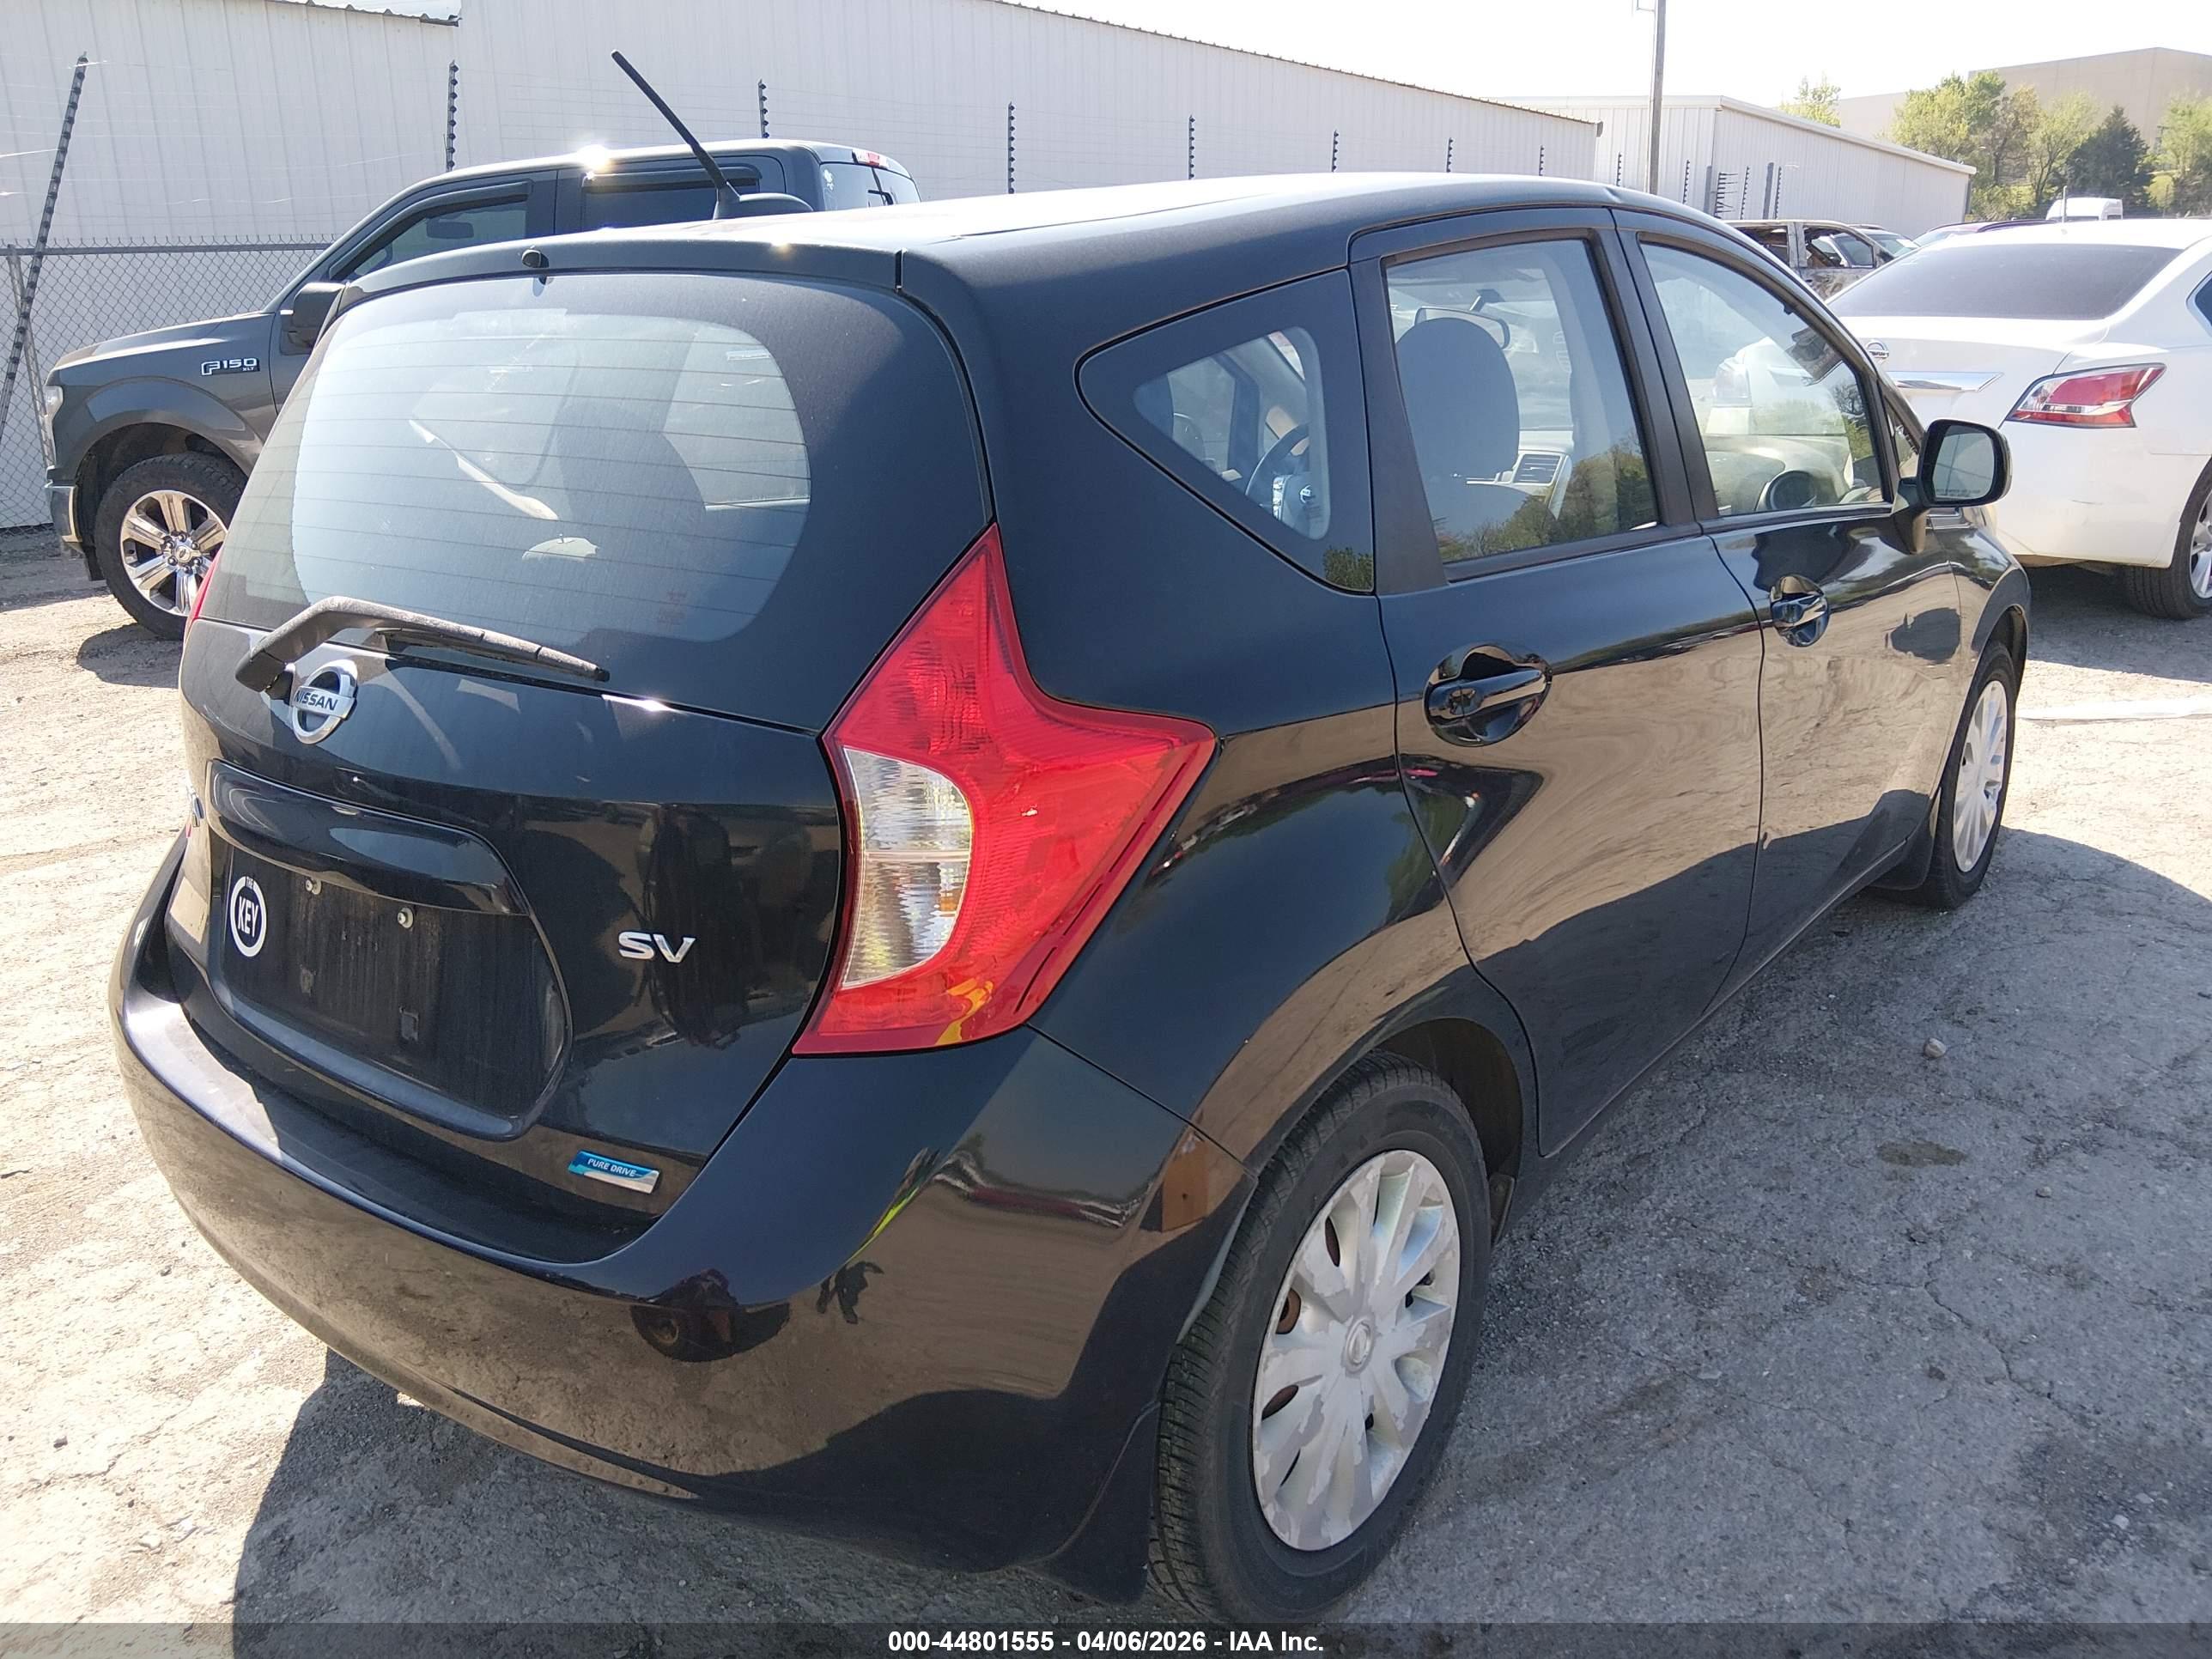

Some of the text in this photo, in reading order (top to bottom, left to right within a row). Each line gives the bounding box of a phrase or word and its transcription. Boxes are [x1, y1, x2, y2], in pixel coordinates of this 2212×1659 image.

[294, 690, 338, 711] NISSAN
[237, 896, 259, 938] KEY
[618, 931, 696, 963] SV
[586, 1158, 637, 1177] PURE DRIVE
